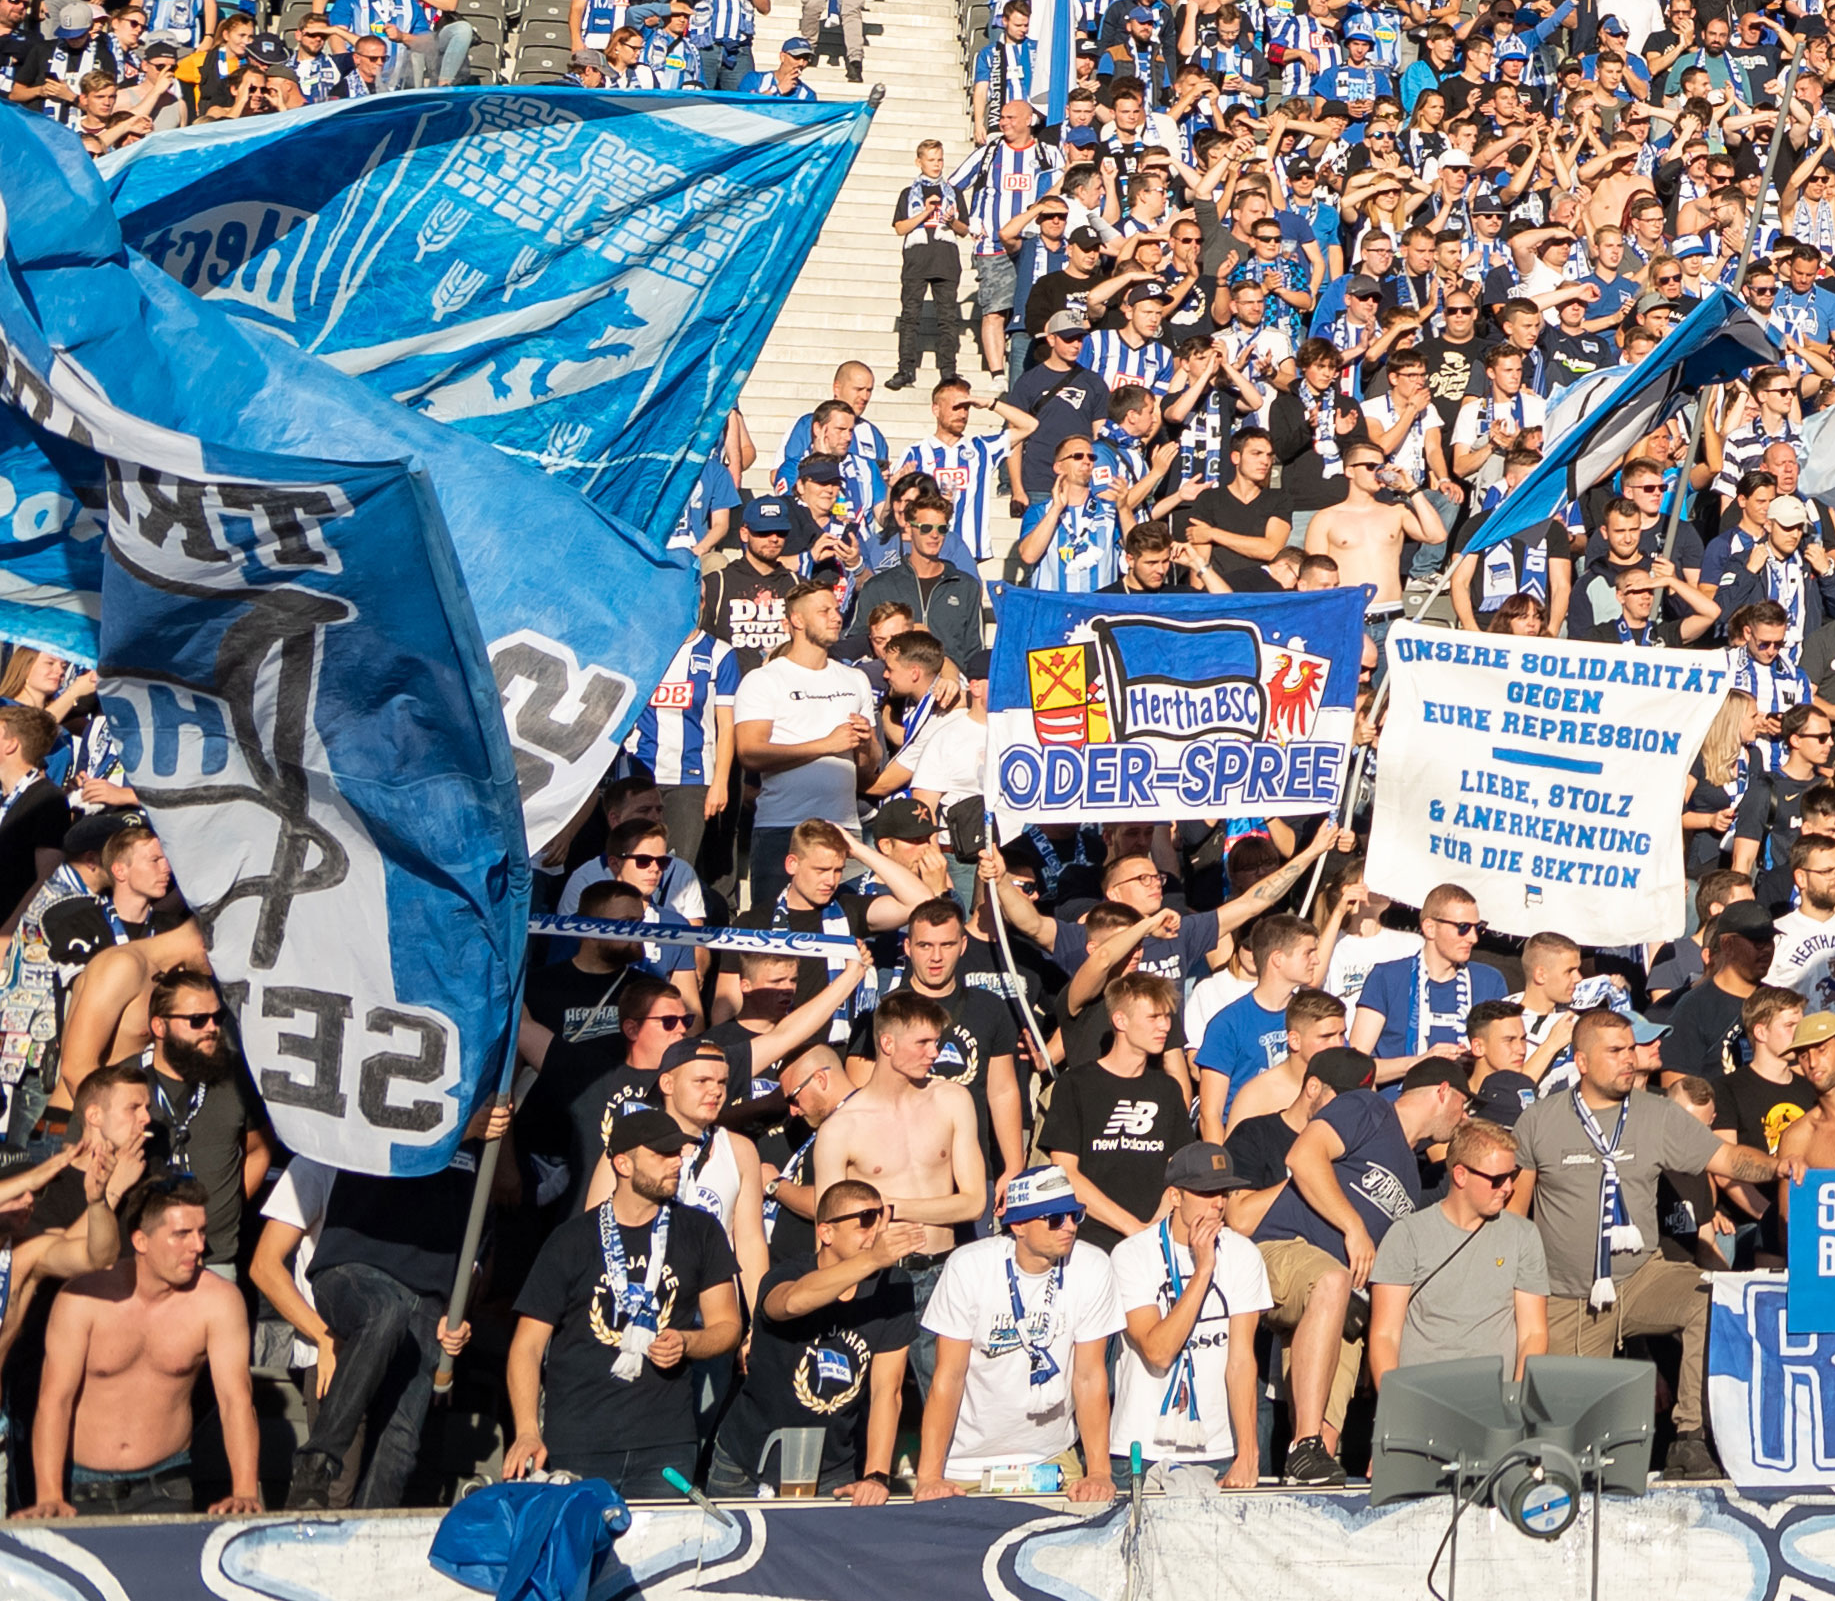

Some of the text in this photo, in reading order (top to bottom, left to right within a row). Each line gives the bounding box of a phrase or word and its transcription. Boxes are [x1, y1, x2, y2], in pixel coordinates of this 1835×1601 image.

[990, 42, 1001, 126] WARSTEINER
[1006, 178, 1029, 191] DB
[655, 684, 686, 705] DB
[1394, 638, 1725, 697] UNSERE SOLIDARITÄT
[1506, 681, 1603, 716] GEGEN
[1423, 700, 1682, 755] EURE REPRESSION
[998, 740, 1343, 807] ODER-SPREE
[1460, 770, 1634, 819] LIEBE, STOLZ
[1429, 800, 1652, 856] & ANERKENNUNG
[1430, 827, 1642, 890] FÜR DIE SEKTION
[1092, 1136, 1164, 1152] new balance
